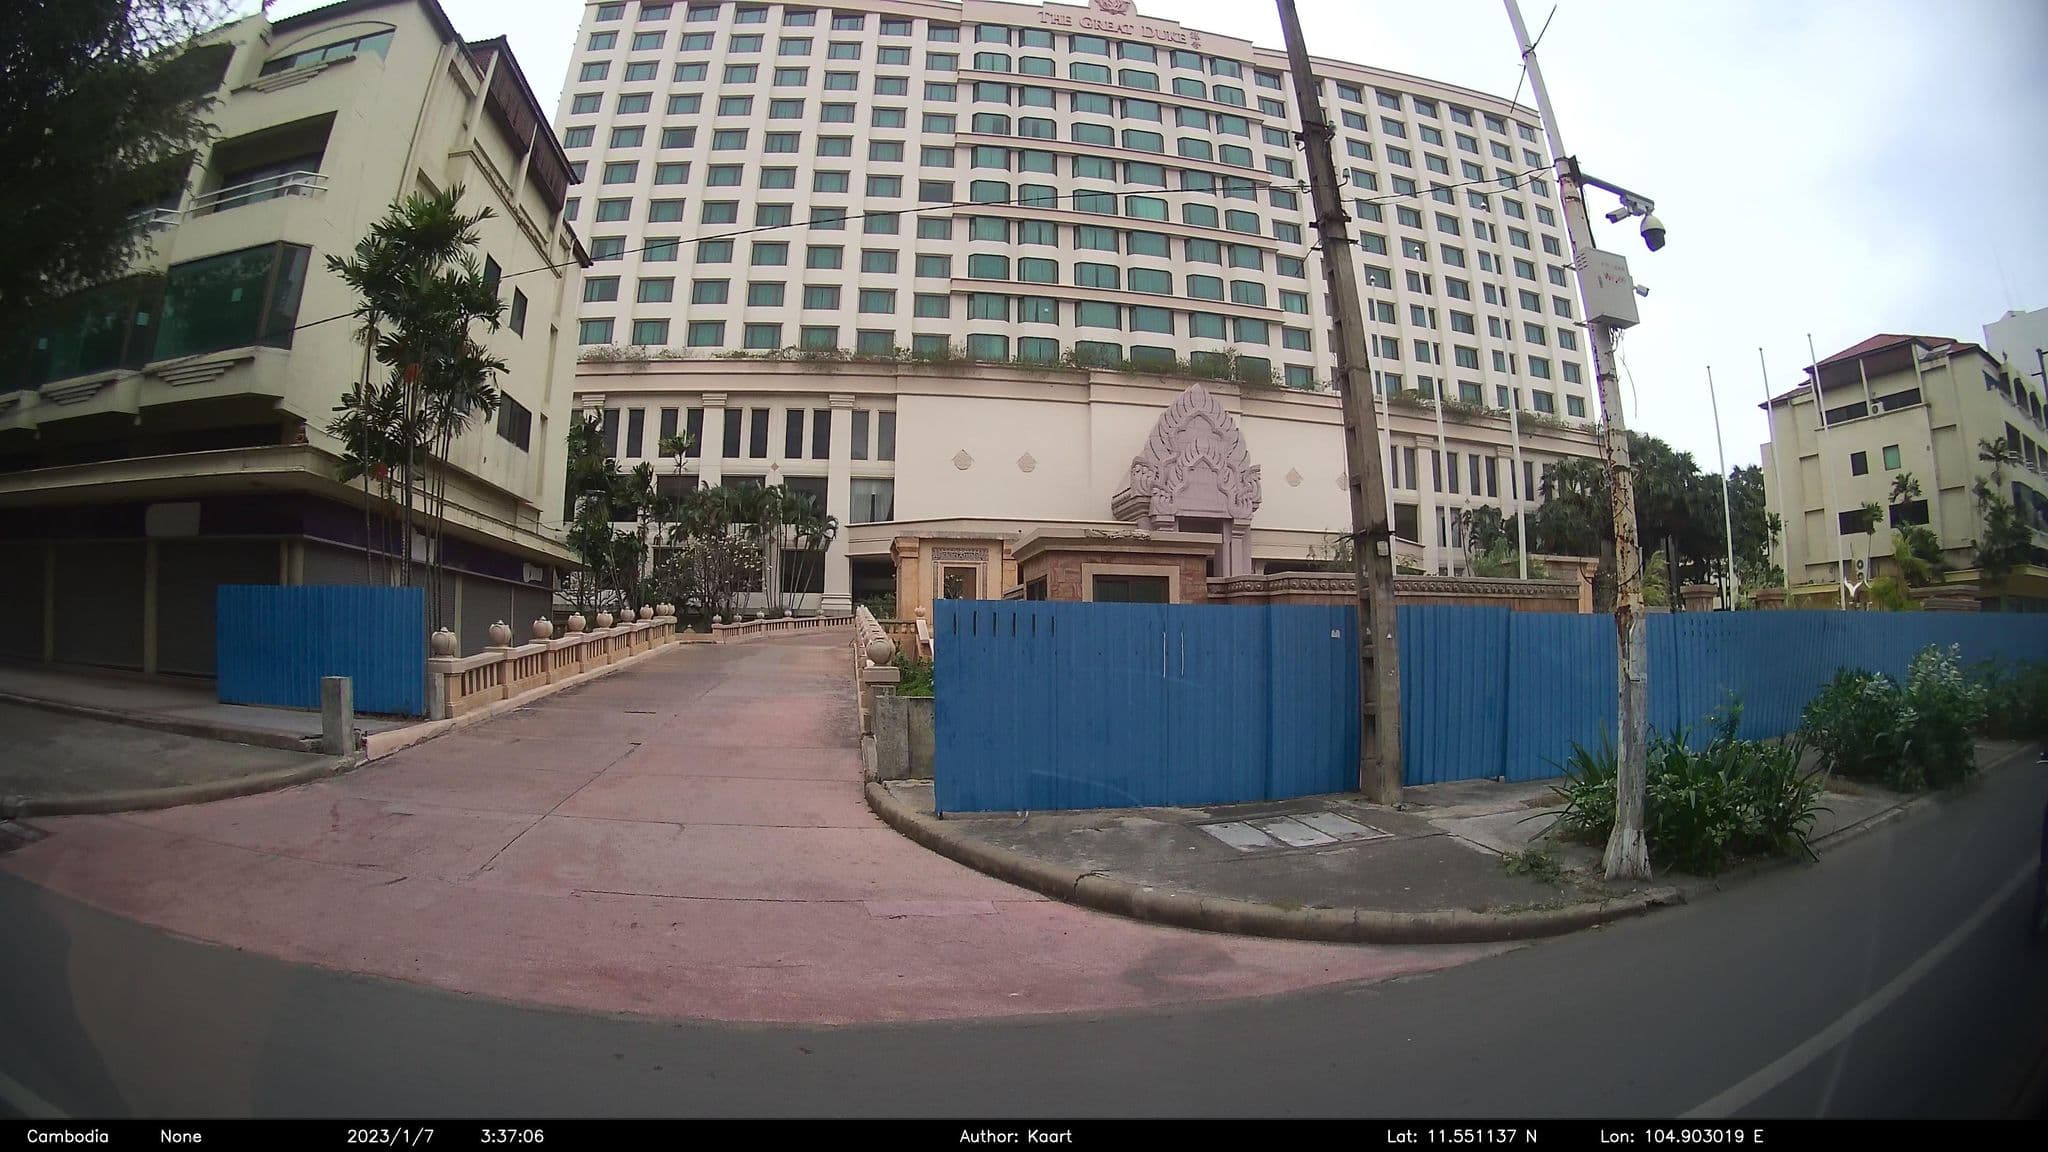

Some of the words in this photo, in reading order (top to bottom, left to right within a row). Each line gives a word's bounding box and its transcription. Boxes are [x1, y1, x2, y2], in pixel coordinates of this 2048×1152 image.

[1038, 11, 1072, 27] THE
[1079, 16, 1134, 35] GREAT
[1141, 25, 1187, 44] DUKE
